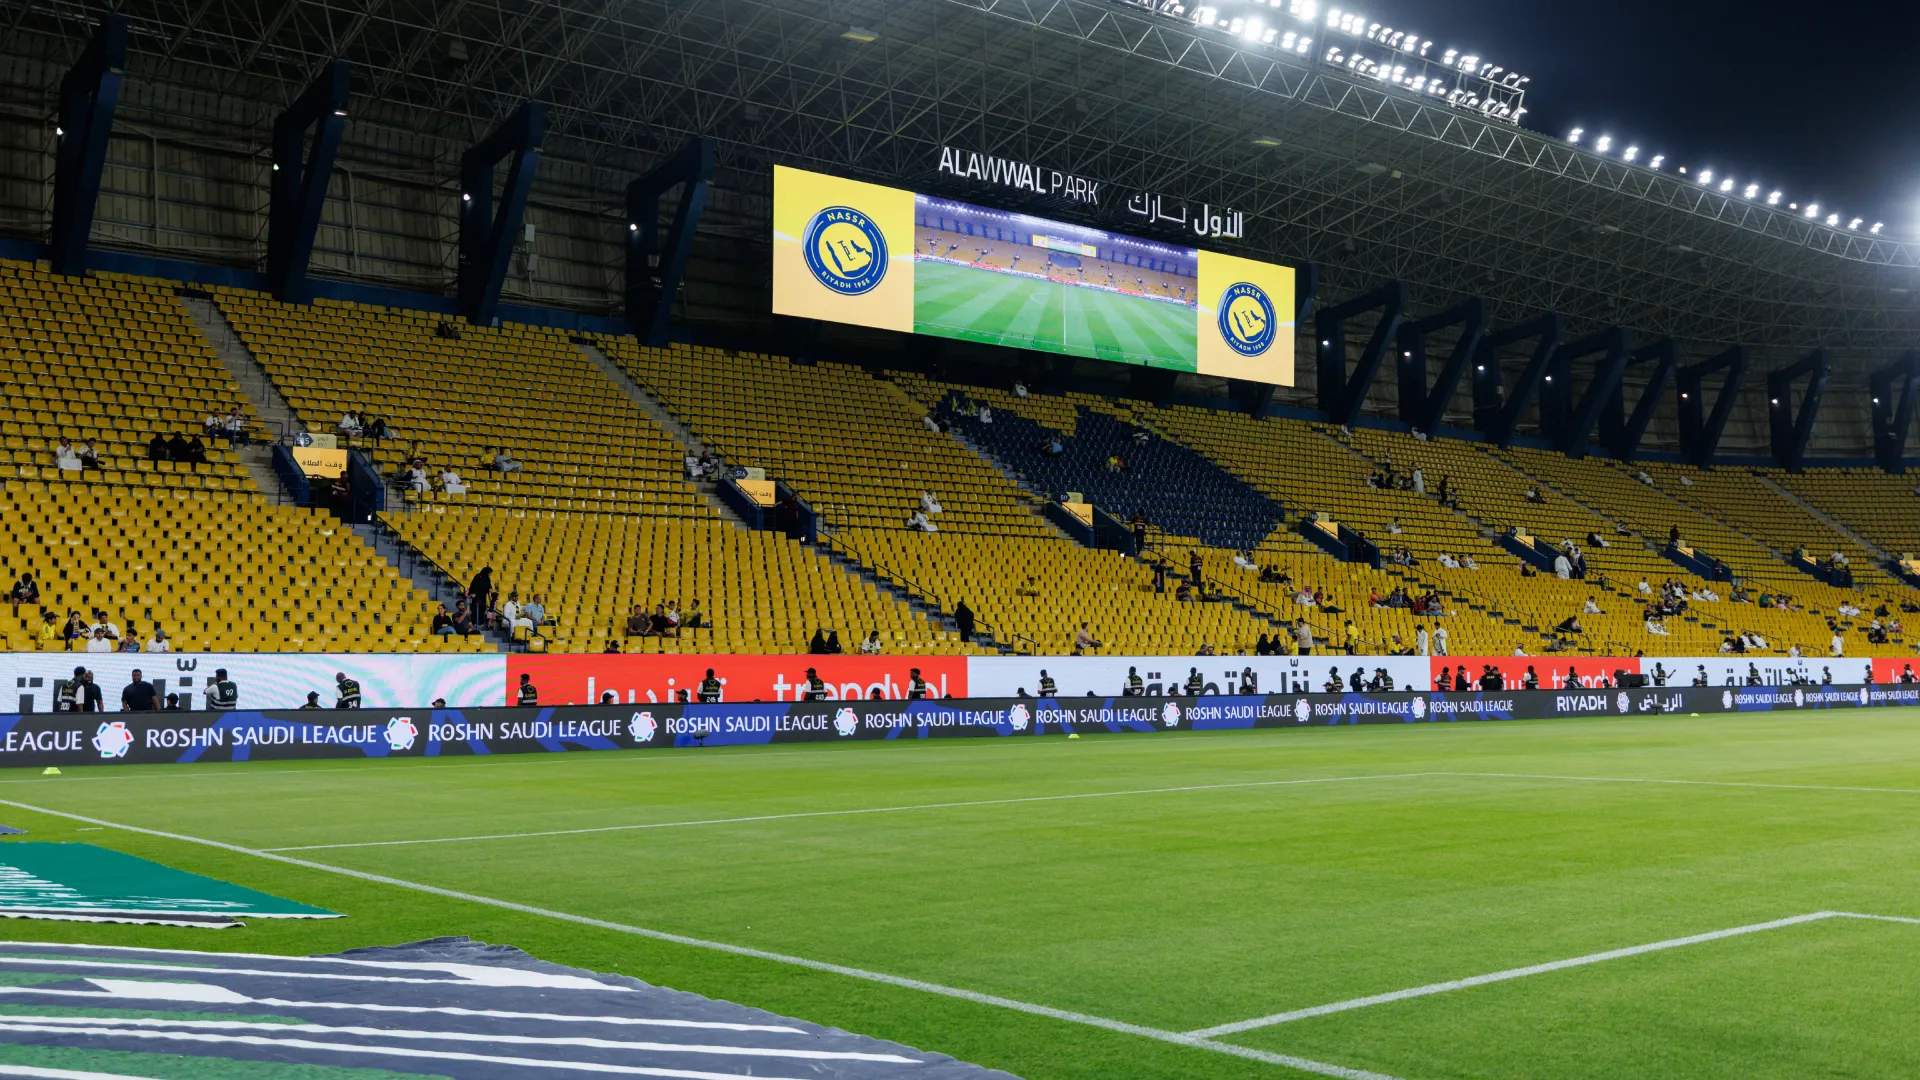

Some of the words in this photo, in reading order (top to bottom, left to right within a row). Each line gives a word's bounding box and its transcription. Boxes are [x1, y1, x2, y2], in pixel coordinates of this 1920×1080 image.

[938, 146, 1047, 194] ALAWWAL
[1051, 171, 1099, 205] PARK
[1129, 192, 1186, 229] بارك
[827, 212, 866, 228] NASSR
[1194, 203, 1243, 238] الأول
[821, 270, 851, 288] RIYADH
[854, 277, 870, 288] 1955
[1234, 286, 1261, 300] NASSR
[325, 461, 342, 470] وقت
[1315, 702, 1347, 716] ROSHN
[1349, 702, 1375, 715] SAUDI
[1378, 701, 1409, 714] LEAGUE
[1430, 700, 1458, 713] ROSHN
[1460, 700, 1483, 713] SAUDI
[1485, 699, 1513, 712] LEAGUE
[1556, 695, 1607, 711] RIYADH
[1639, 693, 1683, 711] الرياض
[865, 713, 912, 728] ROSHN
[916, 711, 955, 727] SAUDI
[959, 710, 1005, 725] LEAGUE
[1035, 709, 1077, 724] ROSHN
[1080, 708, 1114, 723] SAUDI
[1117, 707, 1158, 722] LEAGUE
[1186, 706, 1222, 720] ROSHN
[1224, 705, 1254, 719] SAUDI
[1256, 704, 1292, 718] LEAGUE
[428, 723, 493, 741] ROSHN
[500, 721, 552, 740] SAUDI
[559, 719, 621, 737] LEAGUE
[665, 717, 720, 734] ROSHN
[726, 716, 770, 732] SAUDI
[775, 714, 828, 731] LEAGUE
[146, 728, 223, 748] ROSHN
[231, 726, 294, 745] SAUDI
[302, 725, 377, 744] LEAGUE
